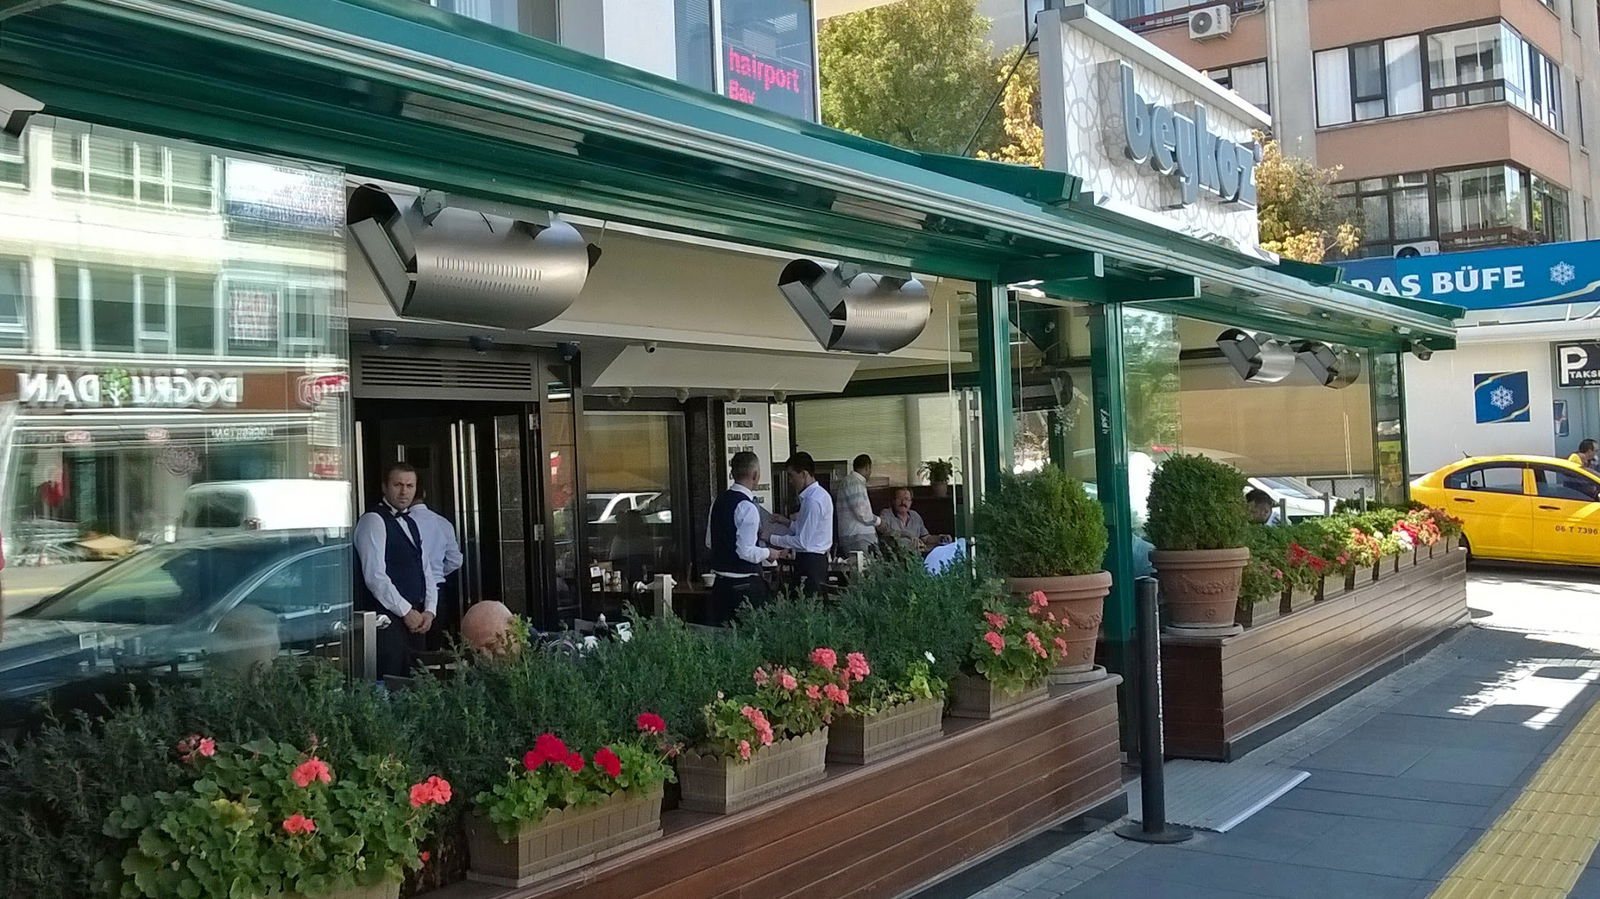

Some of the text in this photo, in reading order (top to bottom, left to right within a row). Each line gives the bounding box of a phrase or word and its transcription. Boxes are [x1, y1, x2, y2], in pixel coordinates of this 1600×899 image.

[729, 46, 799, 93] hairport
[1118, 60, 1258, 206] beykoz
[1431, 265, 1525, 294] BÜFE
[1560, 346, 1588, 384] P
